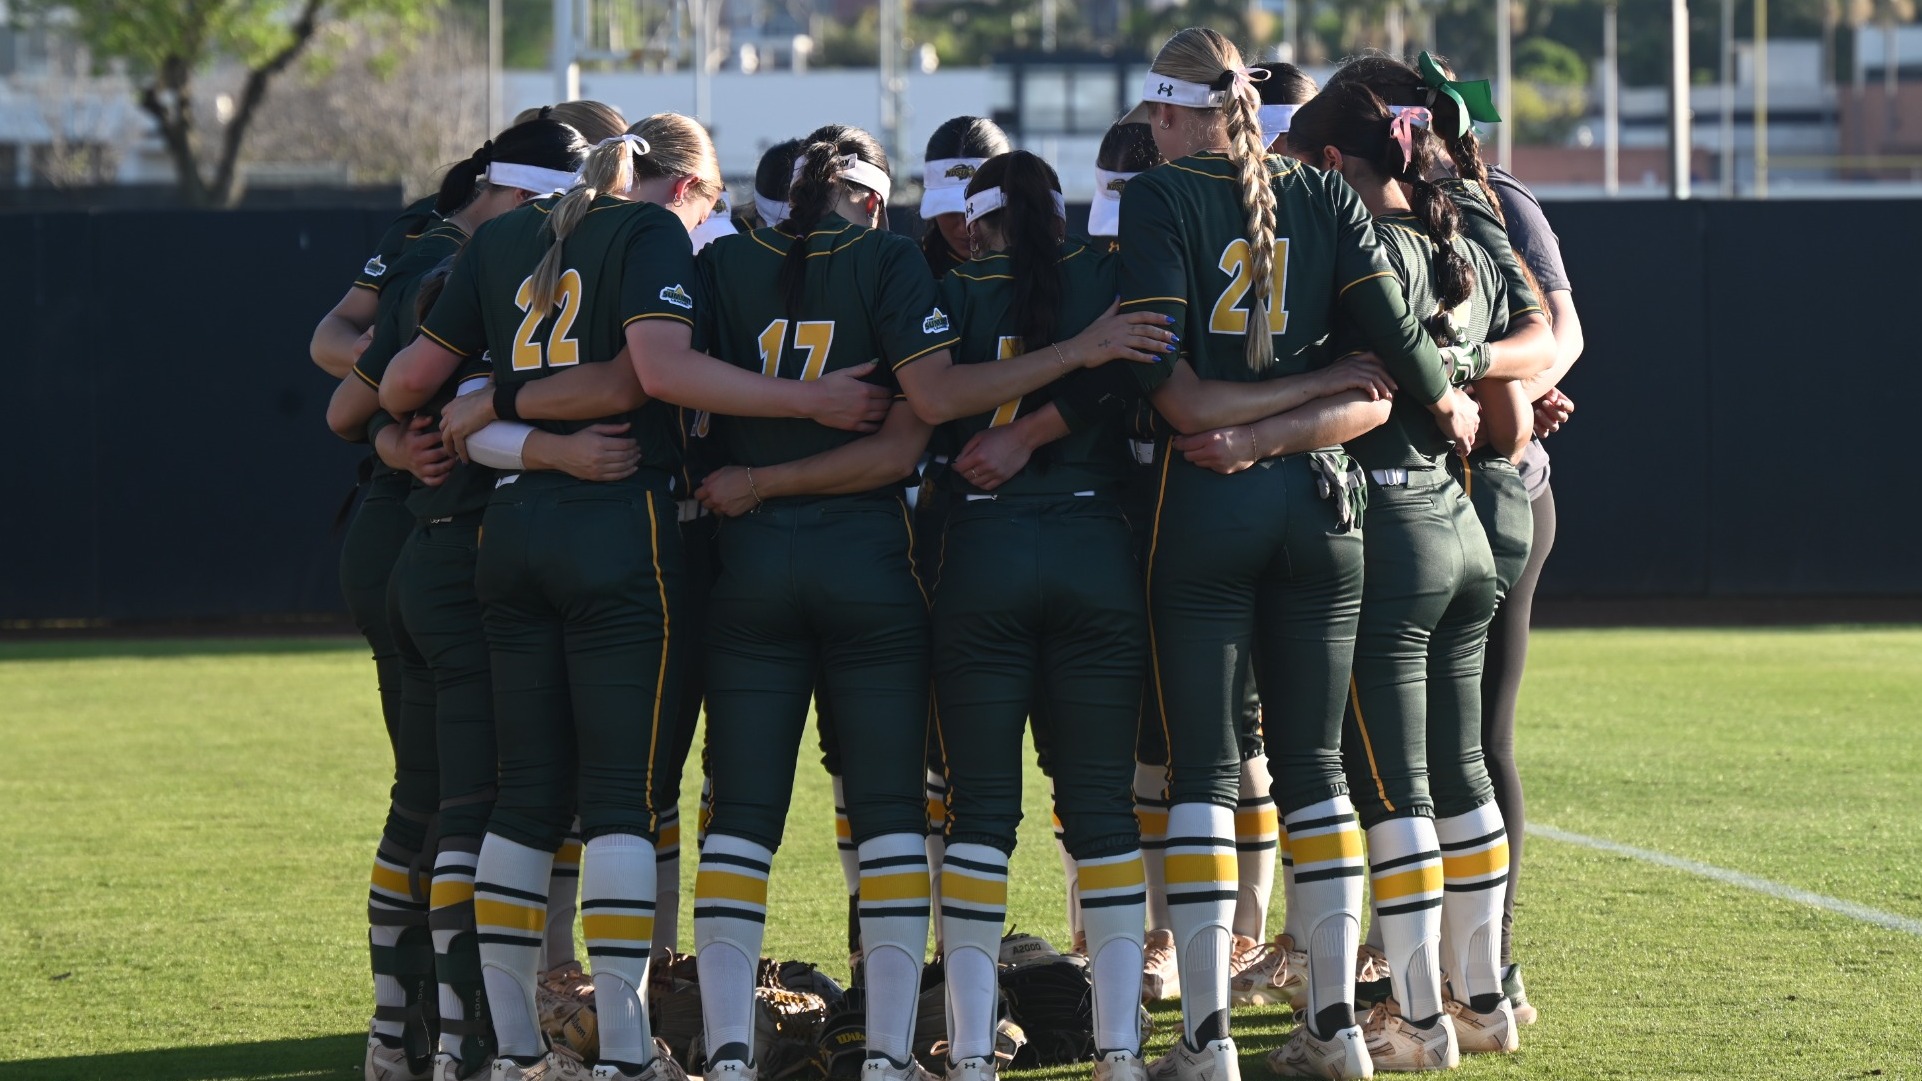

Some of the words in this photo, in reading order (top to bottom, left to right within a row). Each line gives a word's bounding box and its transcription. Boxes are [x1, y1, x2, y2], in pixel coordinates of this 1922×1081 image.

[1209, 238, 1290, 335] 21
[512, 268, 582, 371] 22
[757, 319, 836, 382] 17
[1013, 943, 1042, 955] A2000
[570, 1016, 586, 1038] ilson
